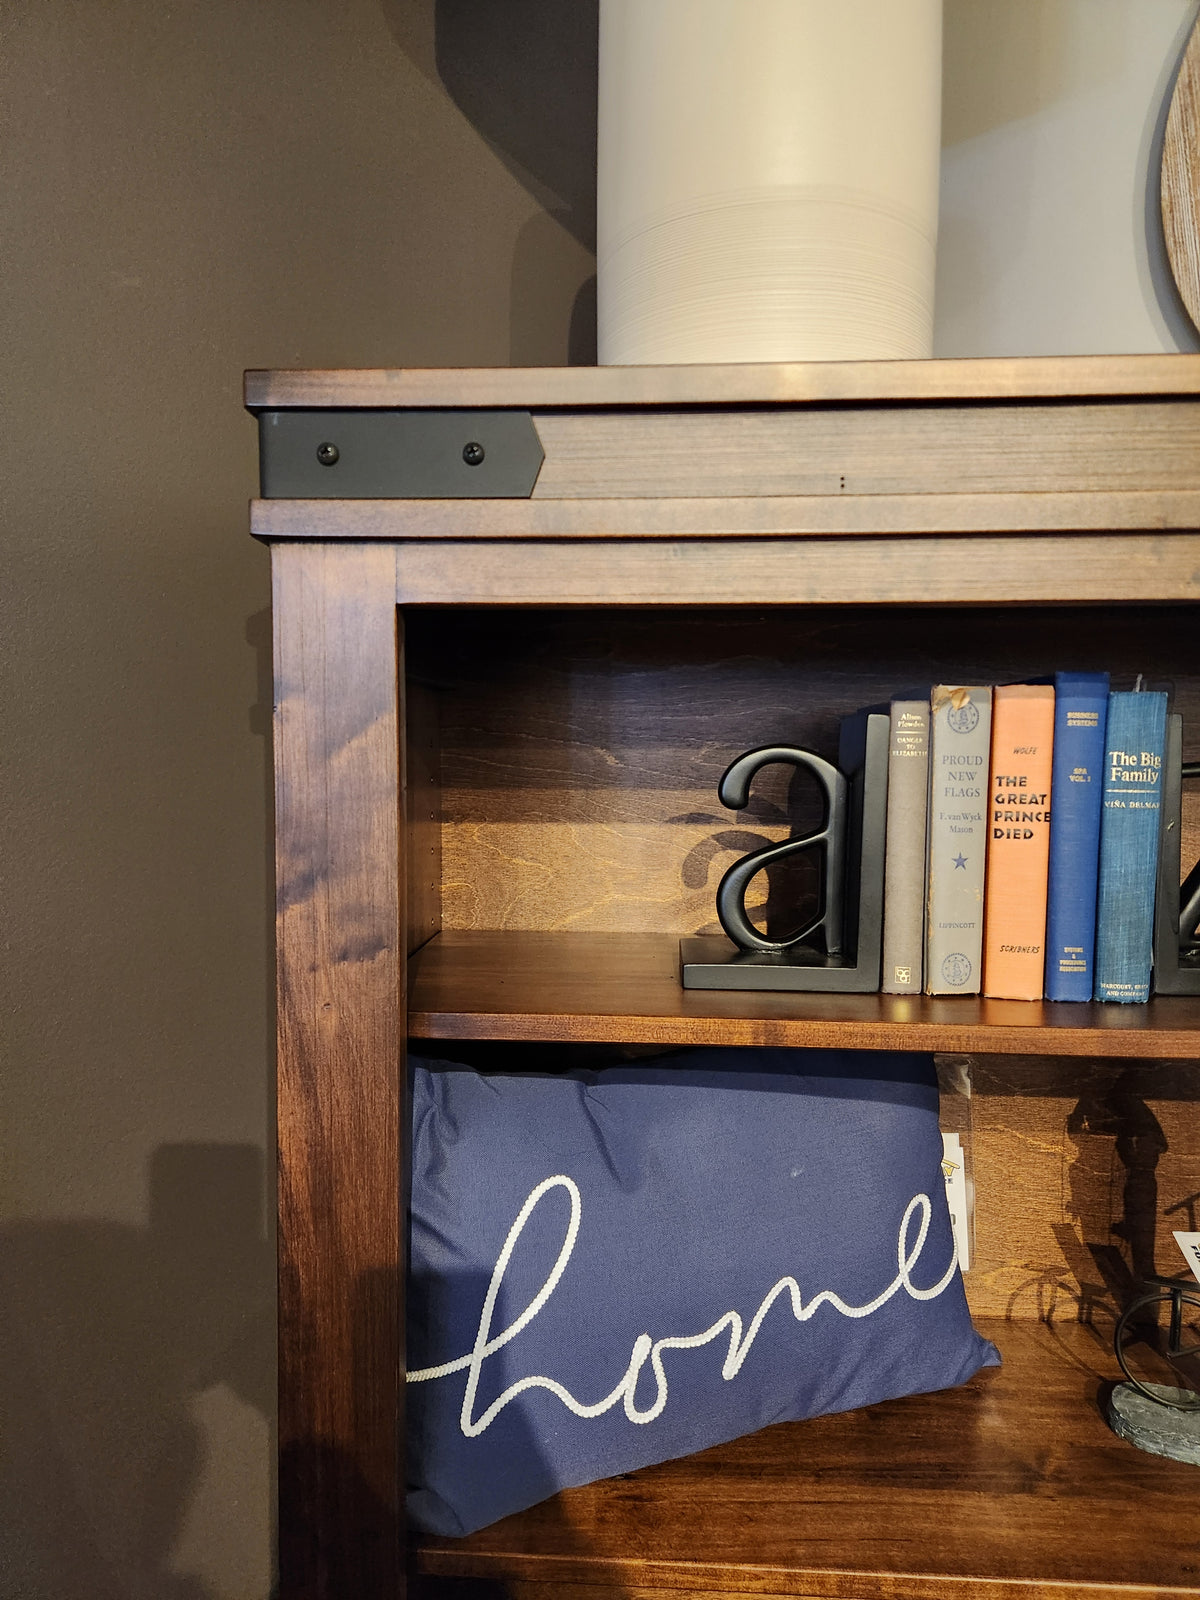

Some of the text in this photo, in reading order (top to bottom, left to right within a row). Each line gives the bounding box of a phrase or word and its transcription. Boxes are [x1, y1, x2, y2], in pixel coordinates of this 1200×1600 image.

[1013, 746, 1038, 755] WOLFE
[942, 755, 983, 765] PROUD
[1109, 751, 1161, 769] The Big
[948, 771, 978, 781] NEW
[1110, 766, 1159, 785] Family
[995, 776, 1028, 787] THE
[944, 787, 981, 797] FLAGS
[994, 793, 1047, 805] GREAT
[994, 811, 1051, 822] PRINCE
[949, 825, 974, 833] Mason
[993, 828, 1034, 839] DIED
[999, 945, 1040, 953] SCRIBNERS
[406, 1174, 959, 1438] home
